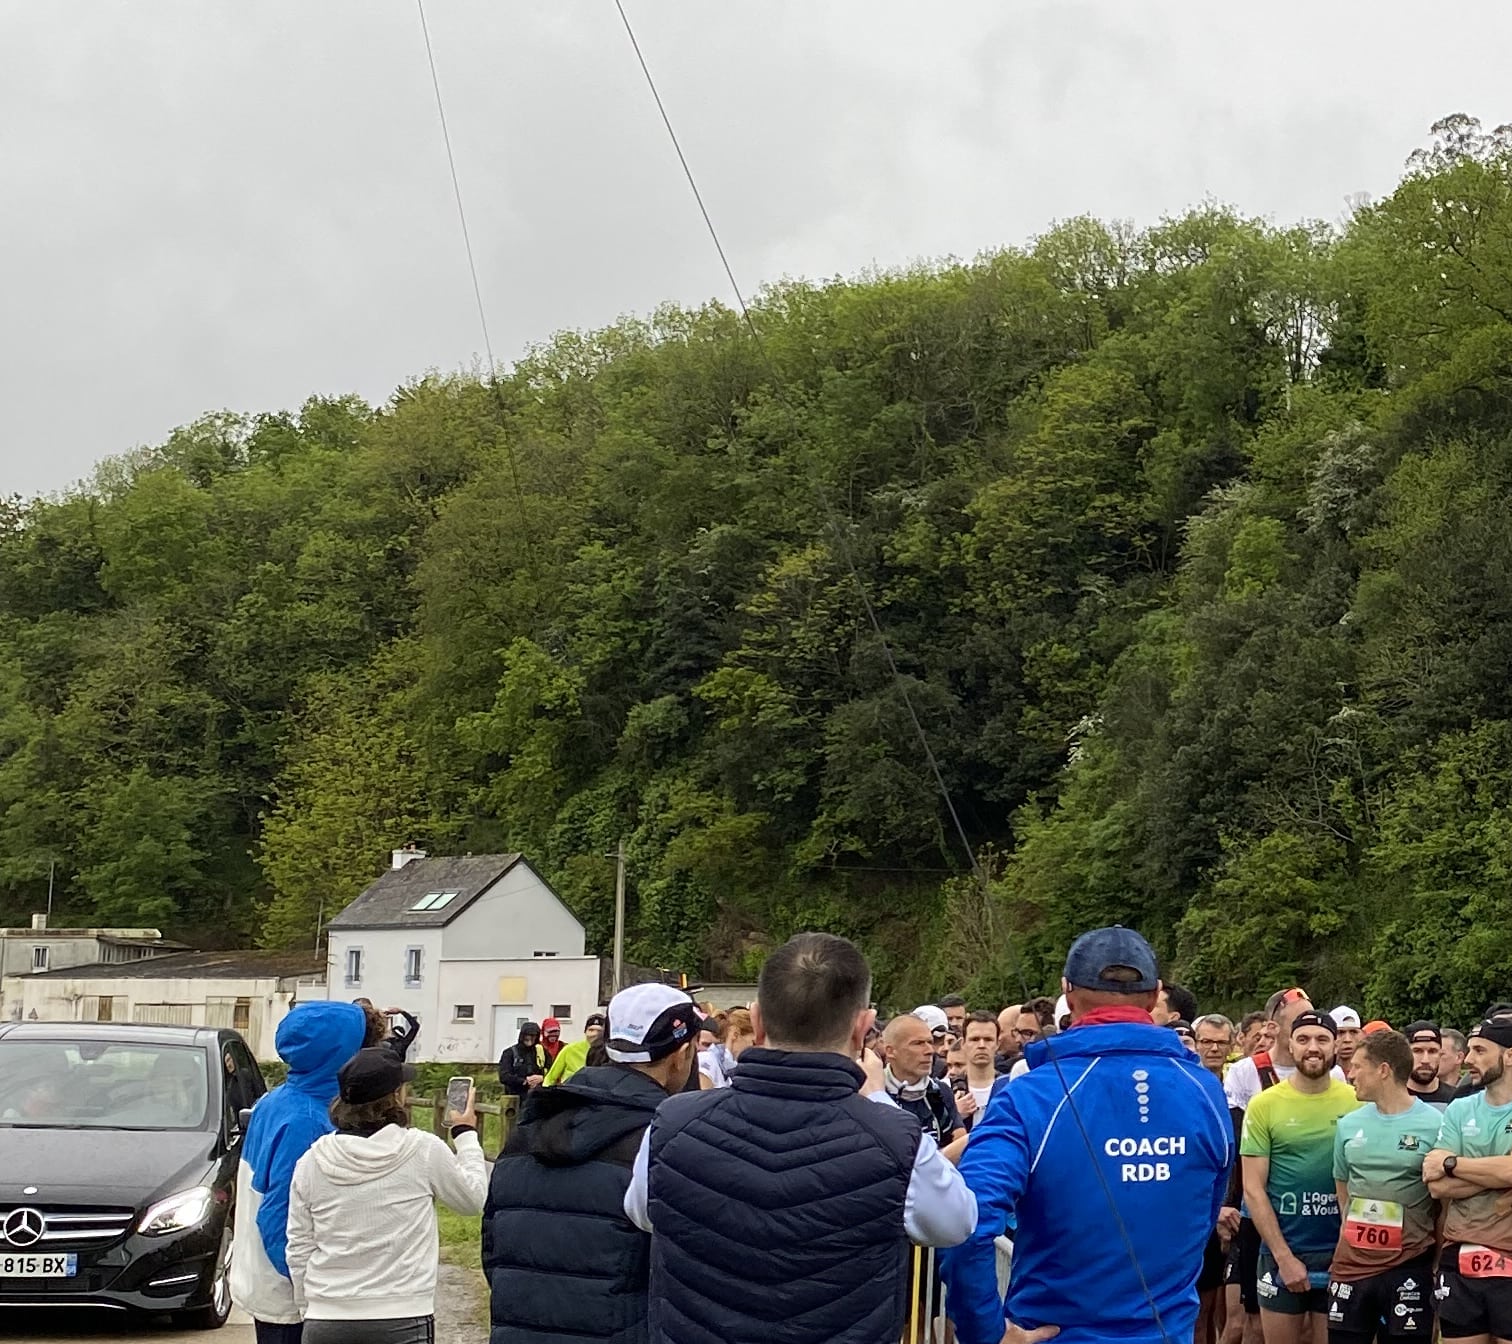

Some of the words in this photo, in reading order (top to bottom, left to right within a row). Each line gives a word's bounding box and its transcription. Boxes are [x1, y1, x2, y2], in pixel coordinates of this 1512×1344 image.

[1104, 1136, 1186, 1157] COACH
[1121, 1162, 1171, 1182] RDB
[1301, 1204, 1312, 1216] &
[1312, 1204, 1339, 1216] Vous
[1356, 1225, 1390, 1246] 760
[1471, 1254, 1506, 1273] 624
